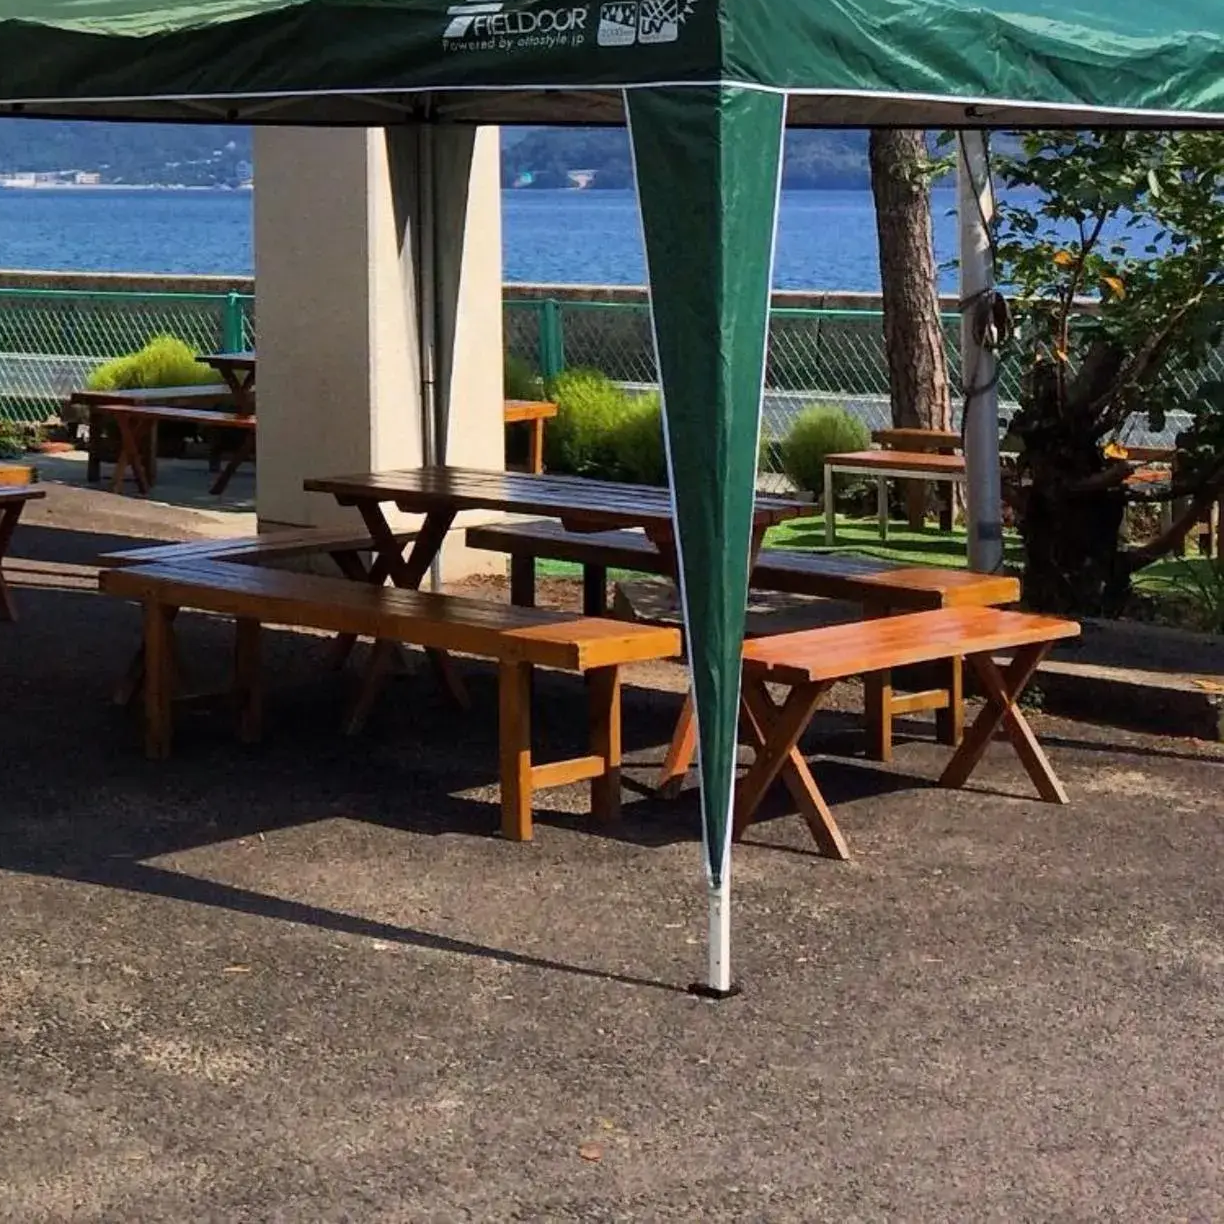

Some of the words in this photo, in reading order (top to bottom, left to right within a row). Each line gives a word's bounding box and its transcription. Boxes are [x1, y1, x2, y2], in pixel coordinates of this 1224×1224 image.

[473, 7, 588, 36] FIELDOOR
[442, 35, 496, 51] Powered
[498, 35, 513, 51] by
